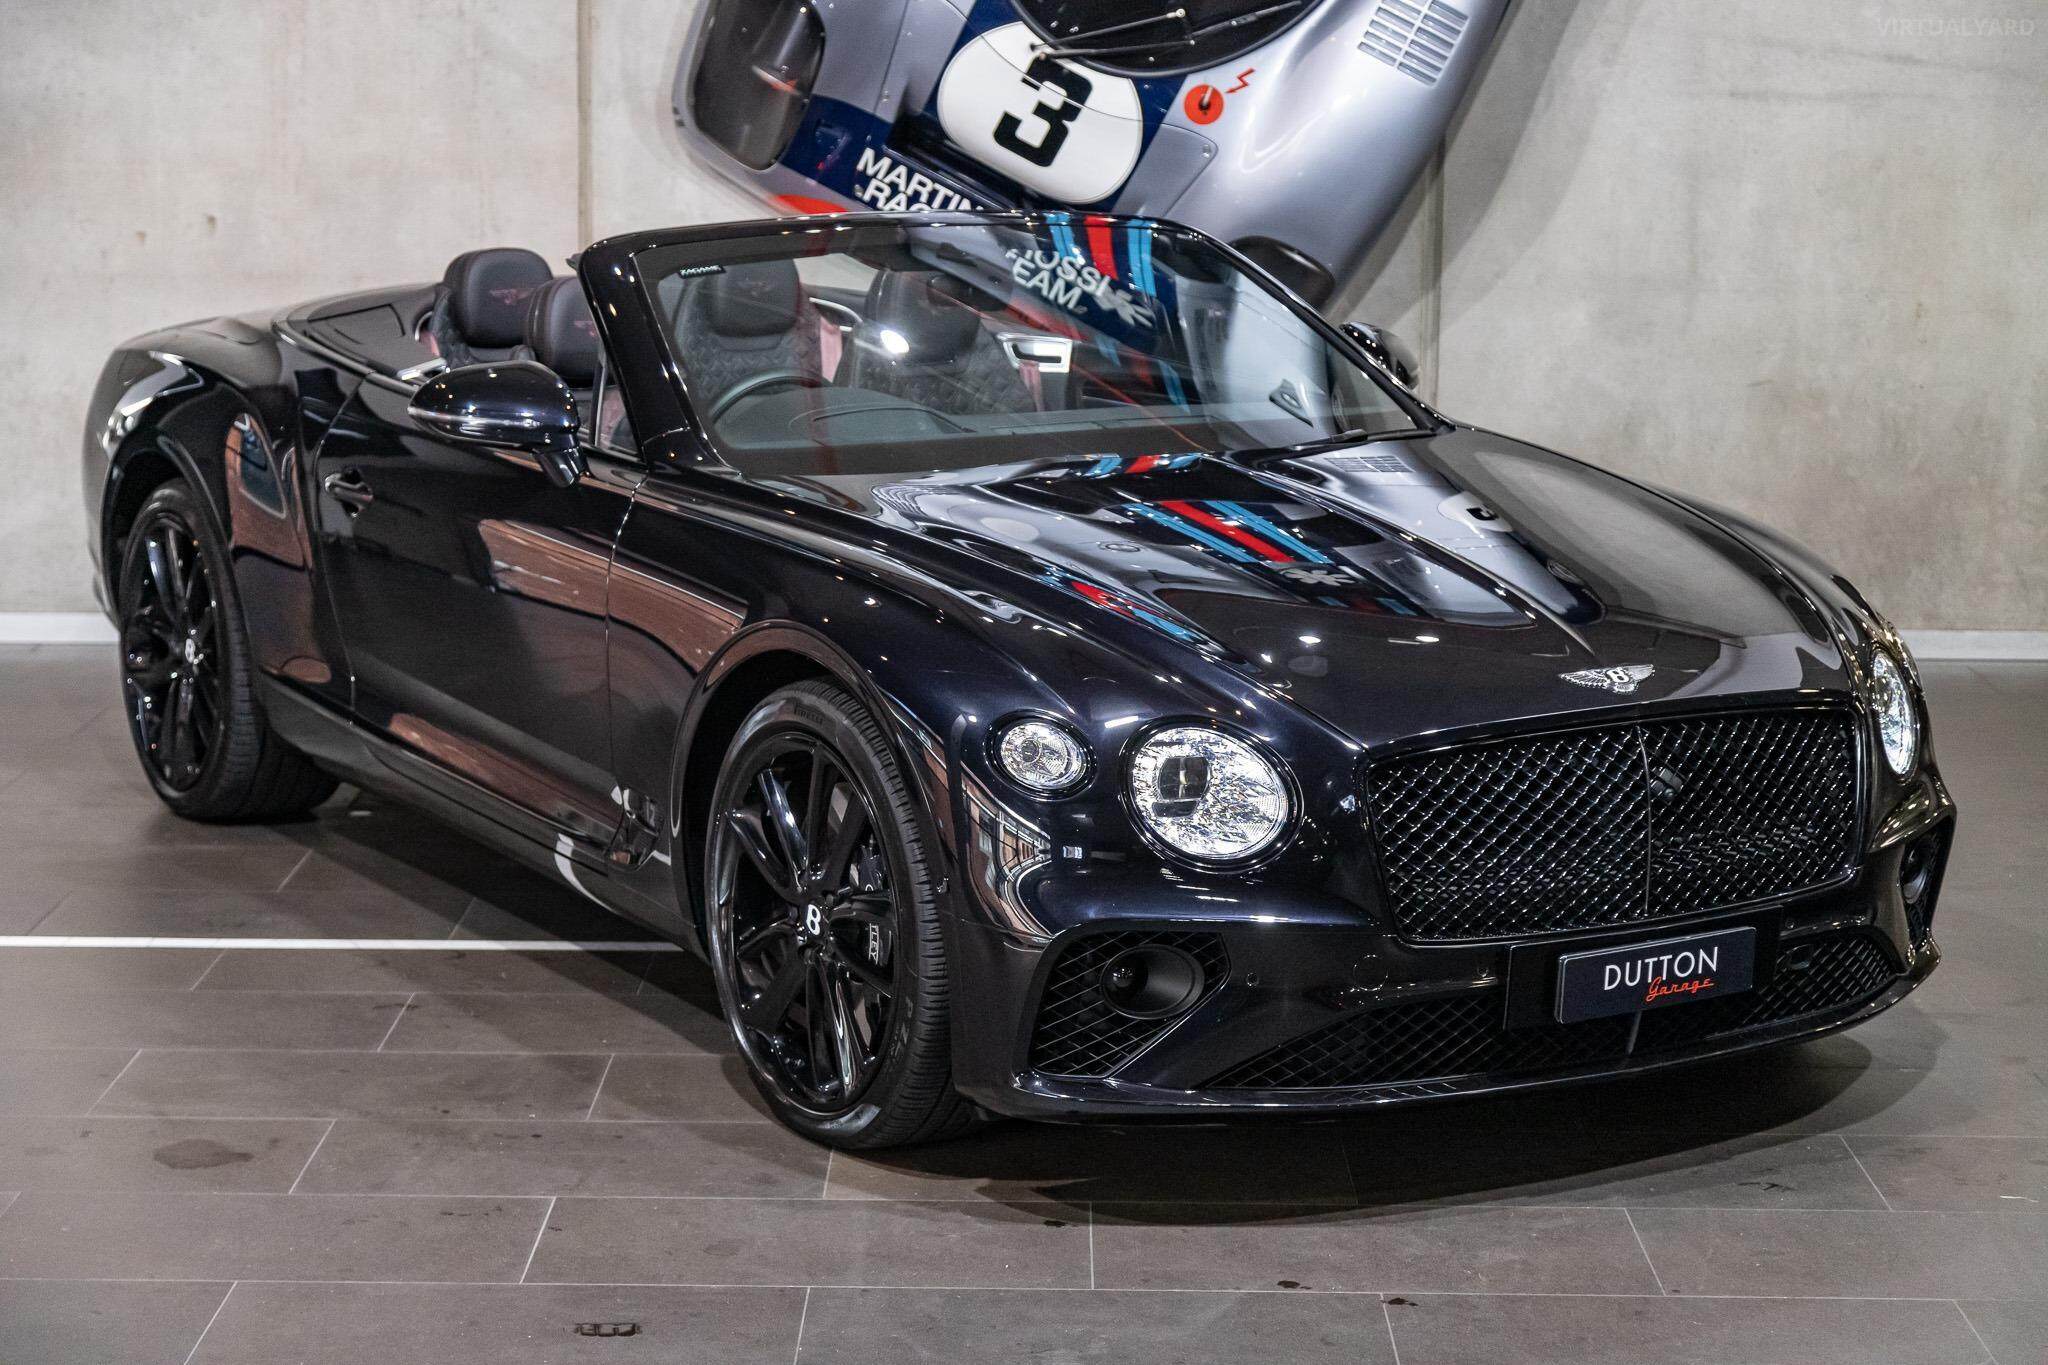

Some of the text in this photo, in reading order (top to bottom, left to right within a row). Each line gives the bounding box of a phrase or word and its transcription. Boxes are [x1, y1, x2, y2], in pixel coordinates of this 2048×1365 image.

[993, 55, 1093, 167] 3
[806, 903, 821, 935] B
[1604, 946, 1718, 991] DUTTON
[1646, 976, 1715, 1002] Garage
